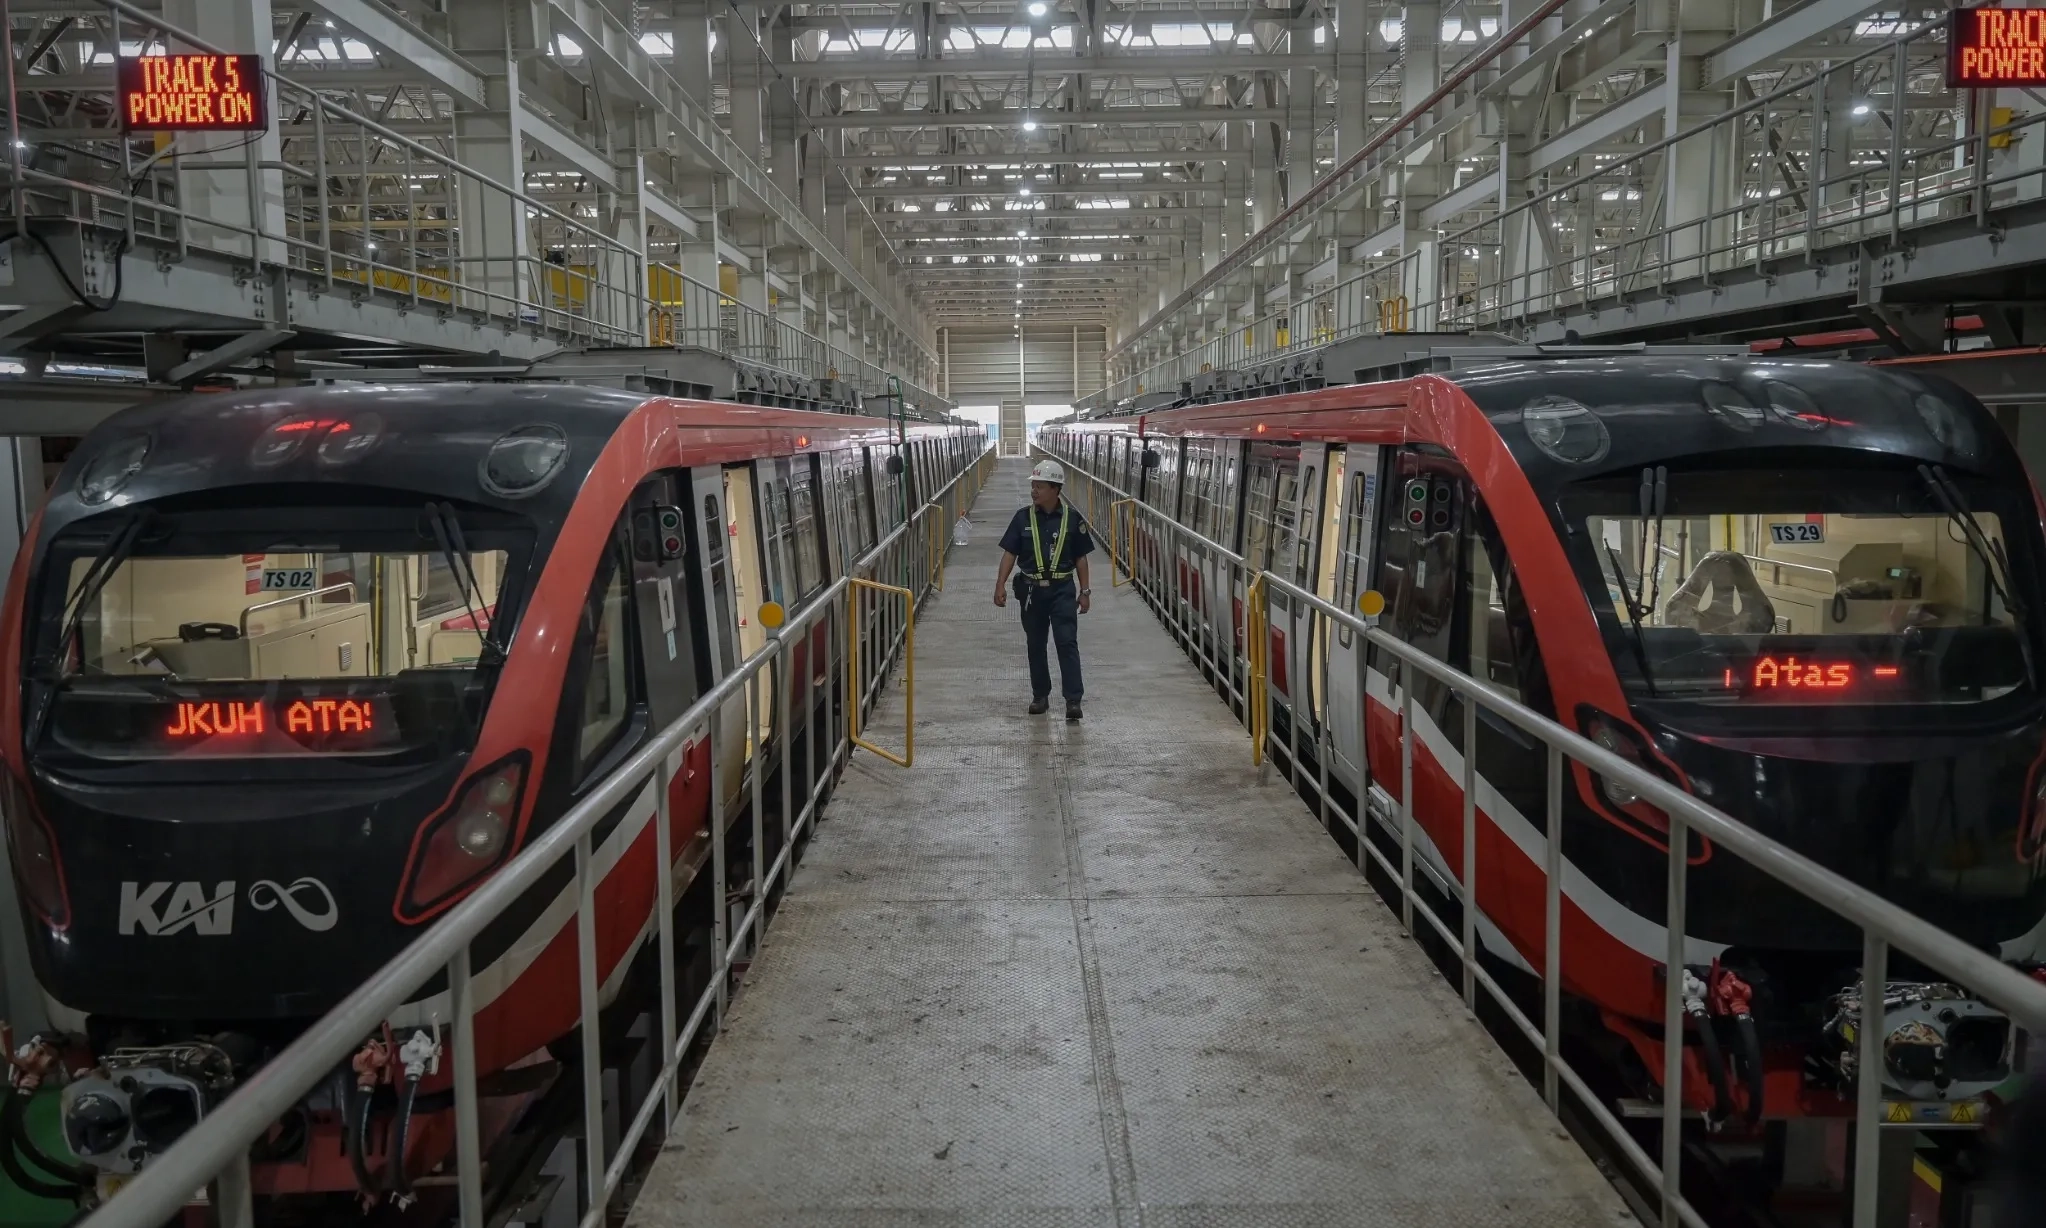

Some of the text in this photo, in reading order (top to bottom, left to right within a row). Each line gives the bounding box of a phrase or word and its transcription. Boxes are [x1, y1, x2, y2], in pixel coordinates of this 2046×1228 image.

[139, 56, 239, 93] TRACK 5
[1963, 47, 2046, 78] POWER
[129, 92, 253, 123] POWER ON
[1772, 525, 1820, 541] TS 29
[265, 571, 287, 588] TS
[289, 571, 313, 588] 02
[1755, 656, 1849, 687] Atas
[288, 700, 372, 732] ATA
[119, 880, 236, 935] KAI
